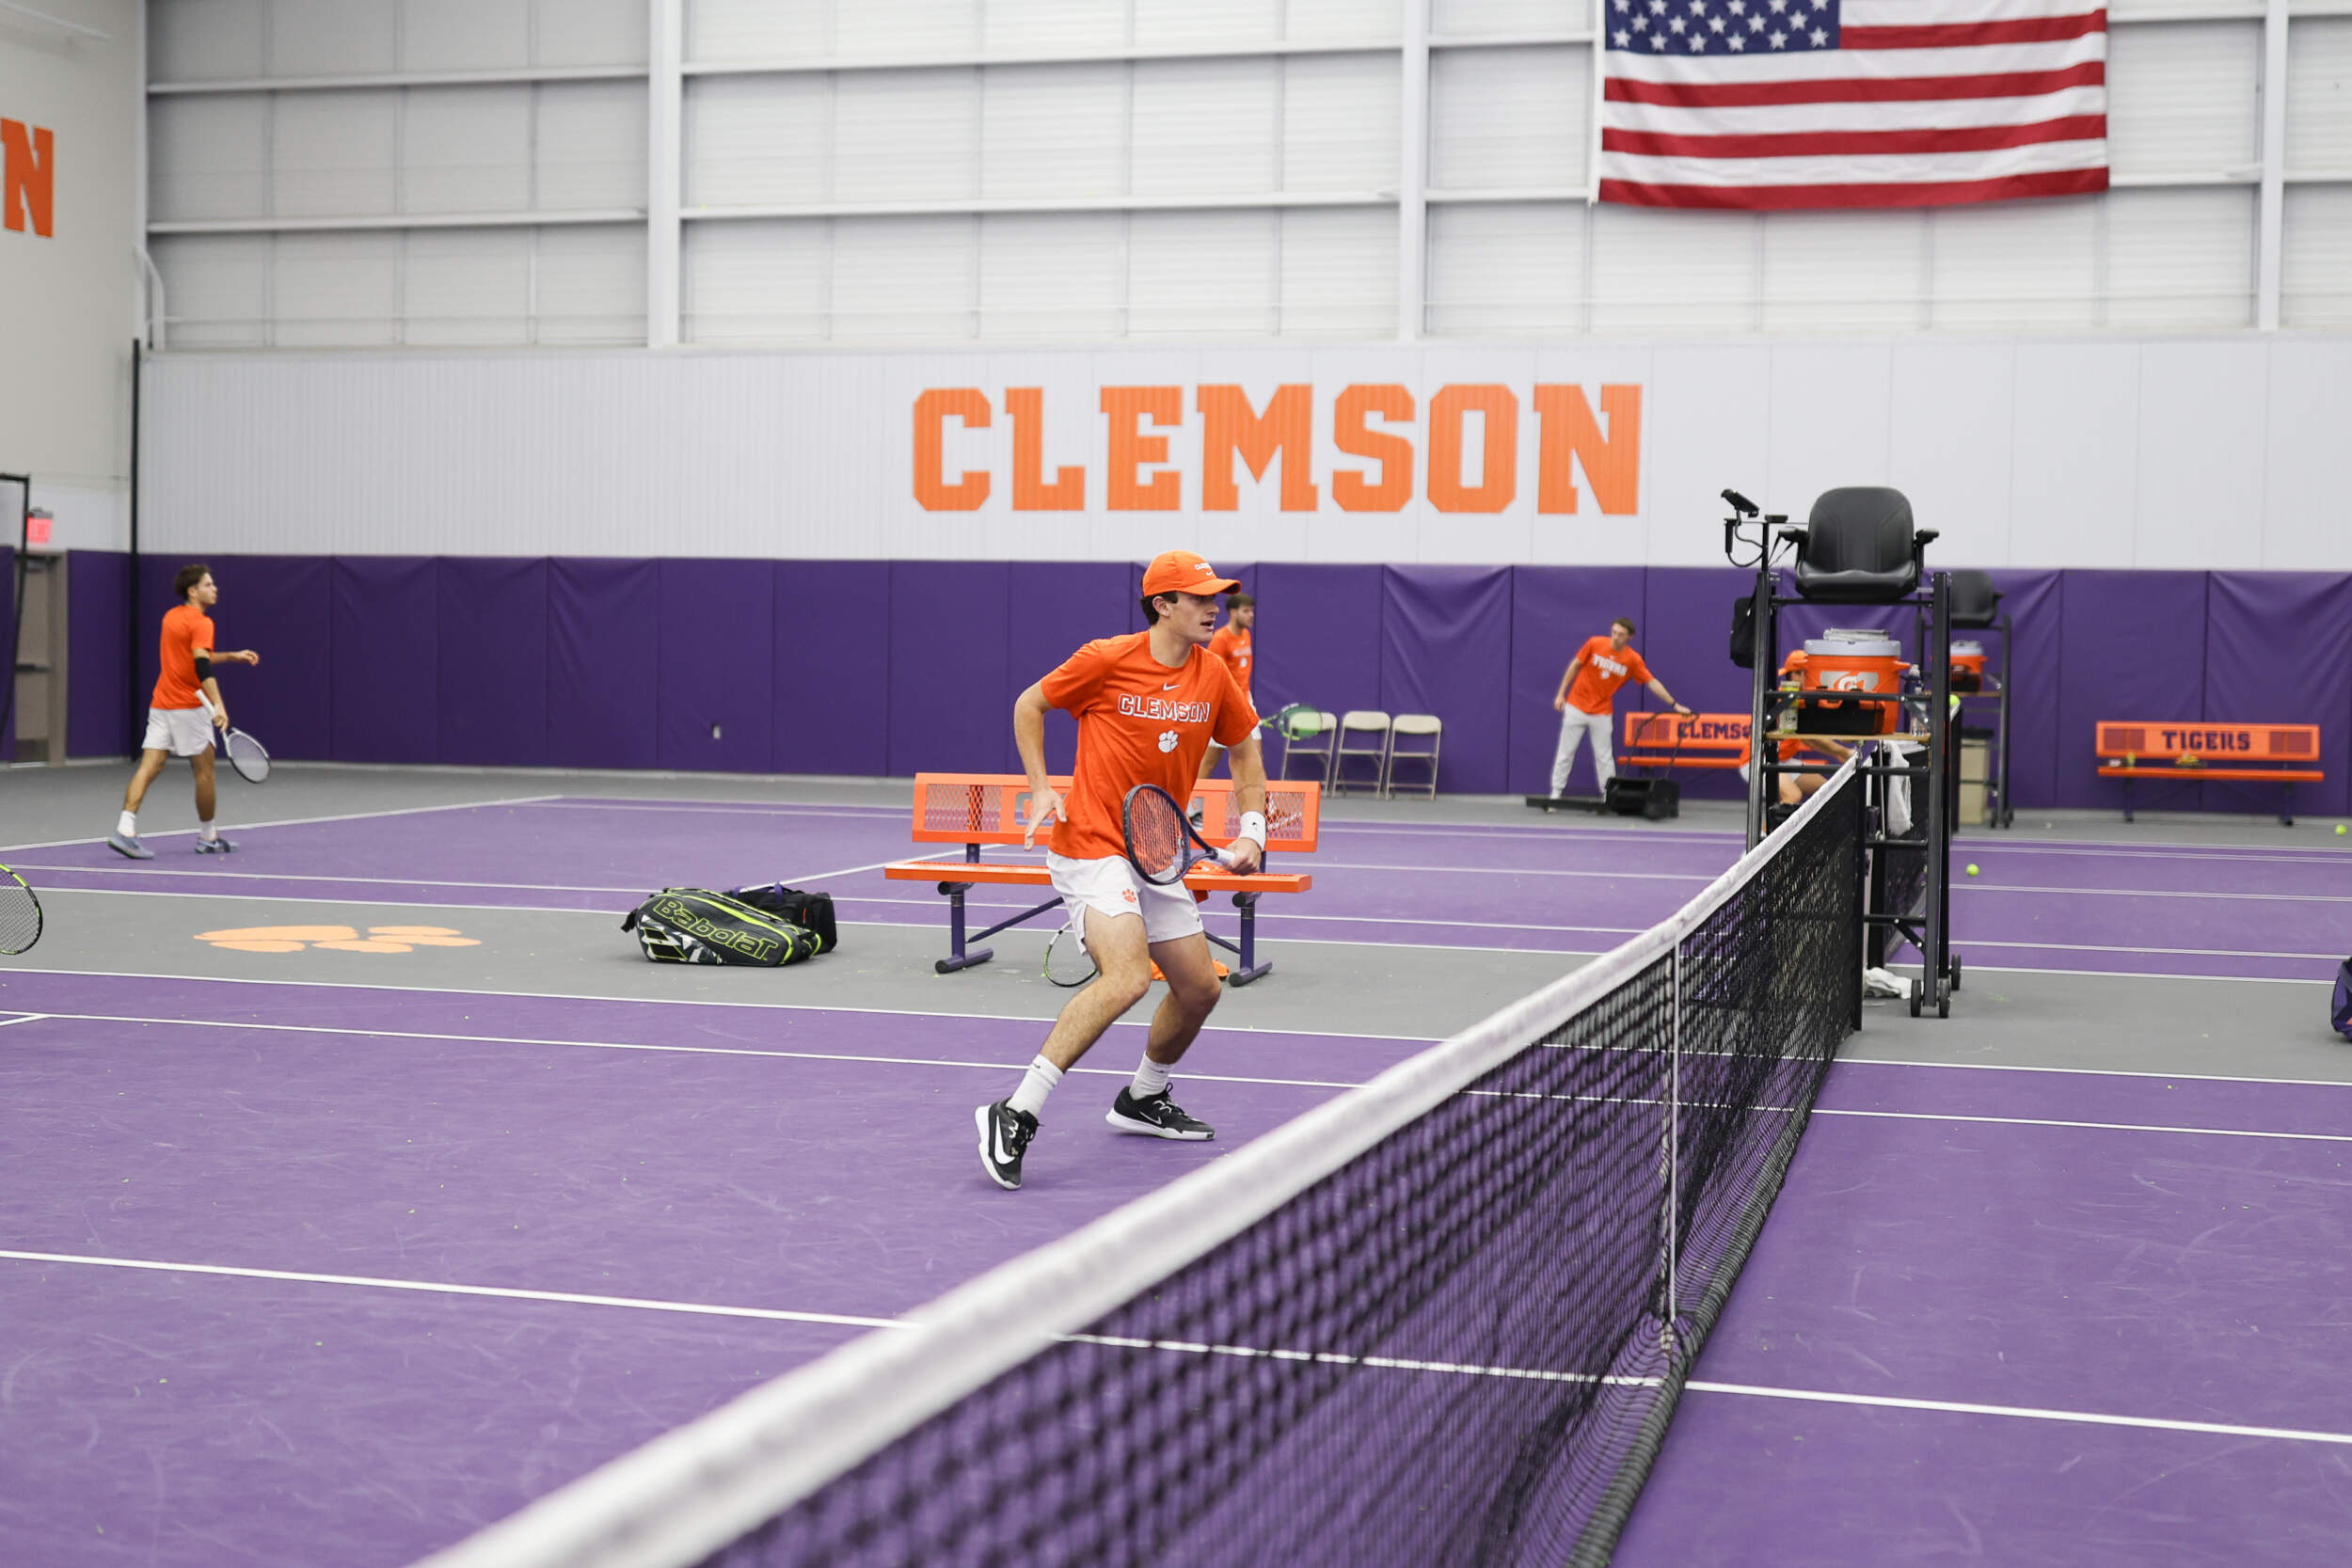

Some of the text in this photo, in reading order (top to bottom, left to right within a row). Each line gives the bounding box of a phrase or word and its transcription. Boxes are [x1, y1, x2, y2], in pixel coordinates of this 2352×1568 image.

[912, 383, 1643, 516] CLEMSON
[1118, 693, 1211, 723] CLEMSON
[2162, 730, 2251, 751] TIGERS
